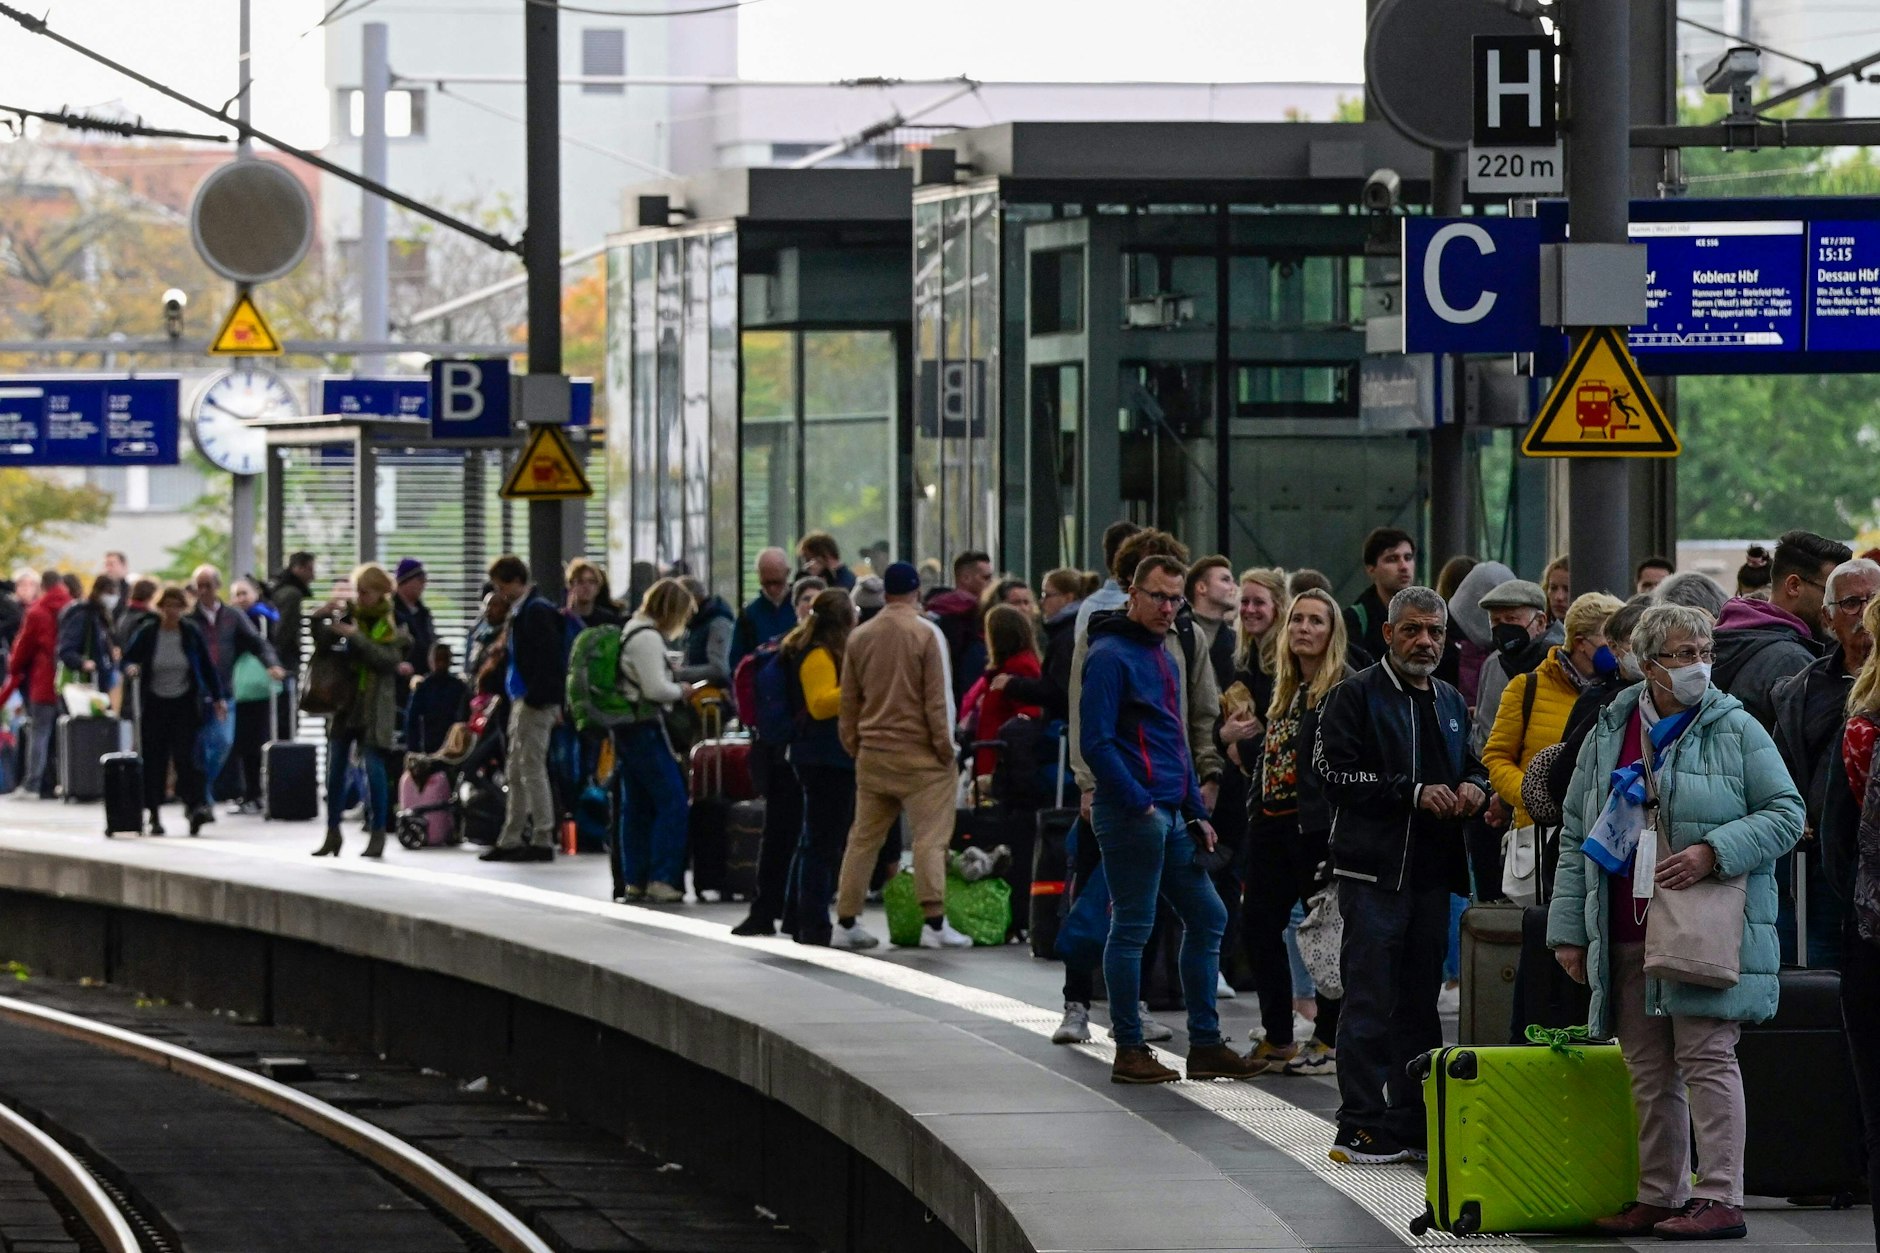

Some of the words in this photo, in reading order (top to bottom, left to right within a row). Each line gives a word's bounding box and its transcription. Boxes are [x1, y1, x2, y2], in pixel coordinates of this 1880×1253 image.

[1487, 49, 1541, 128] H
[1477, 154, 1524, 178] 220
[1530, 160, 1554, 177] m
[1696, 238, 1706, 247] ICE
[1819, 247, 1852, 262] 15:15
[1423, 222, 1498, 324] C
[1693, 270, 1737, 284] Koblenz
[1738, 269, 1759, 283] Hbf
[1817, 268, 1857, 282] Dessau
[1858, 267, 1880, 282] Hbf
[1692, 289, 1723, 297] Hannover
[1692, 299, 1713, 307] Hamm
[441, 362, 485, 420] B
